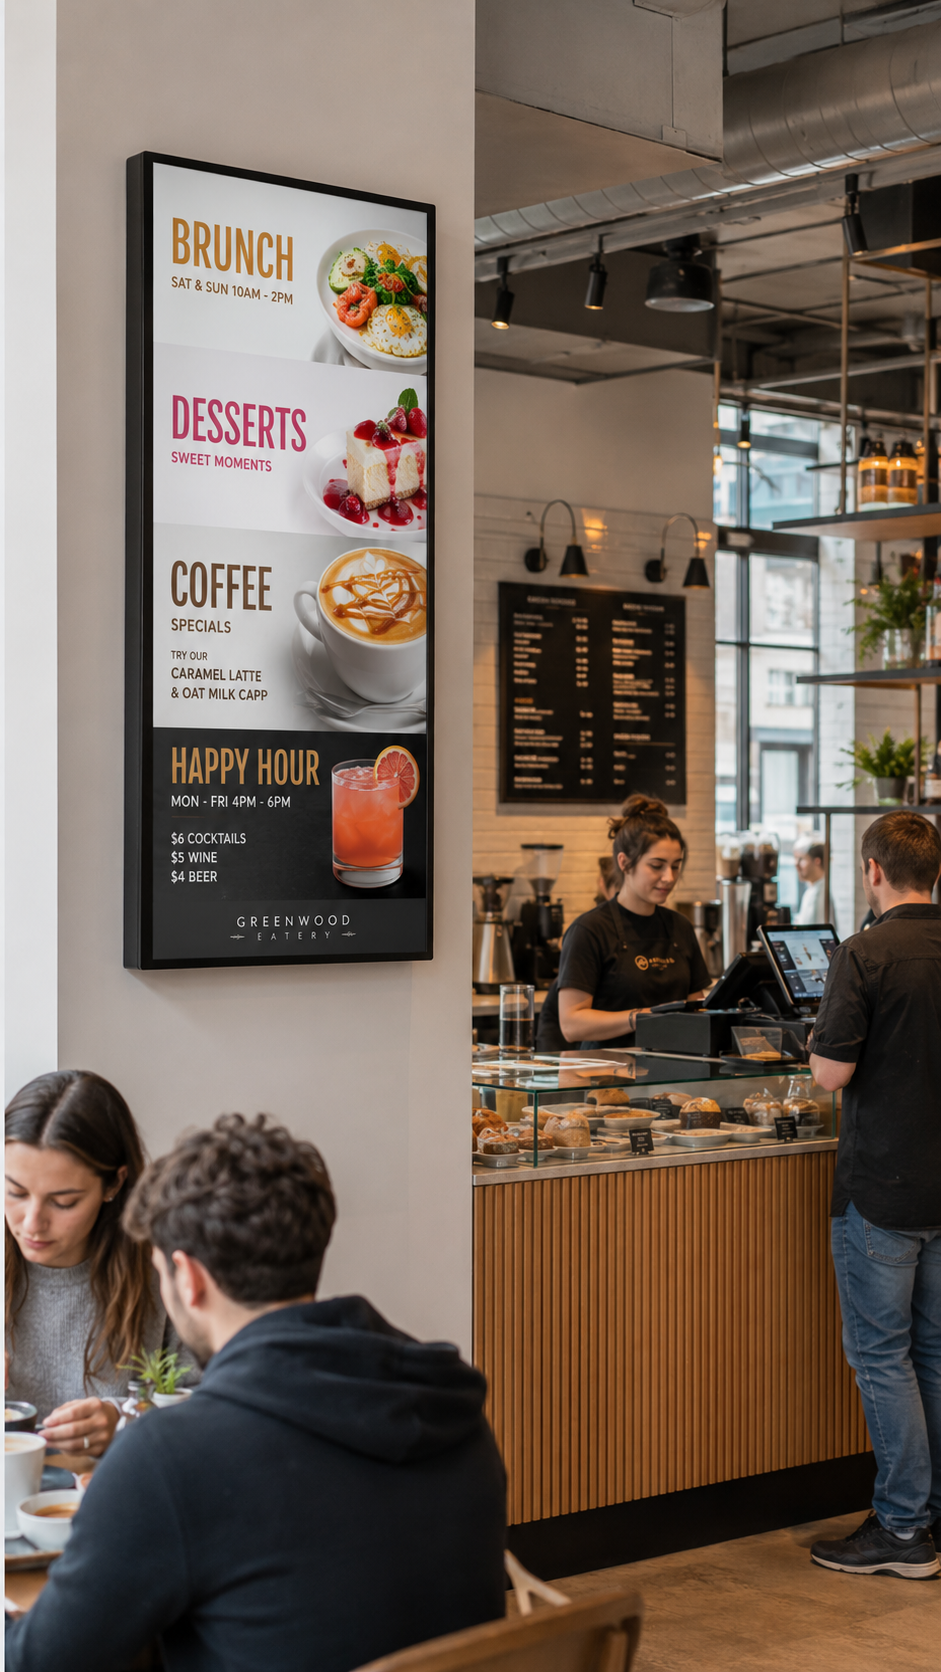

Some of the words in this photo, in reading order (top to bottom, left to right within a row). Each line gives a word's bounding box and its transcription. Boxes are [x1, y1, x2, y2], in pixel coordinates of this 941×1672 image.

[173, 217, 293, 281] BRUNCH
[171, 275, 192, 290] SAT
[195, 279, 202, 291] &
[205, 280, 228, 295] SUN
[231, 284, 260, 300] 10AM
[271, 290, 293, 305] 2PM
[173, 395, 306, 451] DESSERTS
[171, 450, 211, 467] SWEET
[214, 454, 272, 472] MOMENTS
[171, 560, 272, 610] COFFEE
[171, 617, 231, 634] SPECIALS
[171, 649, 188, 660] TRY
[190, 650, 208, 661] OUR
[171, 666, 227, 681] CARAMEL
[228, 669, 262, 683] LATTE
[171, 686, 179, 699] &
[182, 686, 205, 700] OAT
[208, 687, 236, 700] MILK
[238, 688, 268, 701] CAPP
[172, 746, 249, 785] HAPPY
[258, 749, 320, 786] HOUR
[171, 794, 199, 808] MON
[211, 794, 228, 808] FRI
[232, 795, 257, 808] 4PM
[267, 795, 291, 808] 6PM
[171, 831, 185, 845] $6
[188, 831, 247, 845] COCKTAILS
[171, 850, 185, 865] $5
[188, 851, 218, 864] WINE
[171, 869, 185, 884] $4
[188, 870, 218, 883] BEER
[236, 914, 350, 928] GREENWOOD
[257, 931, 331, 941] EATERY
